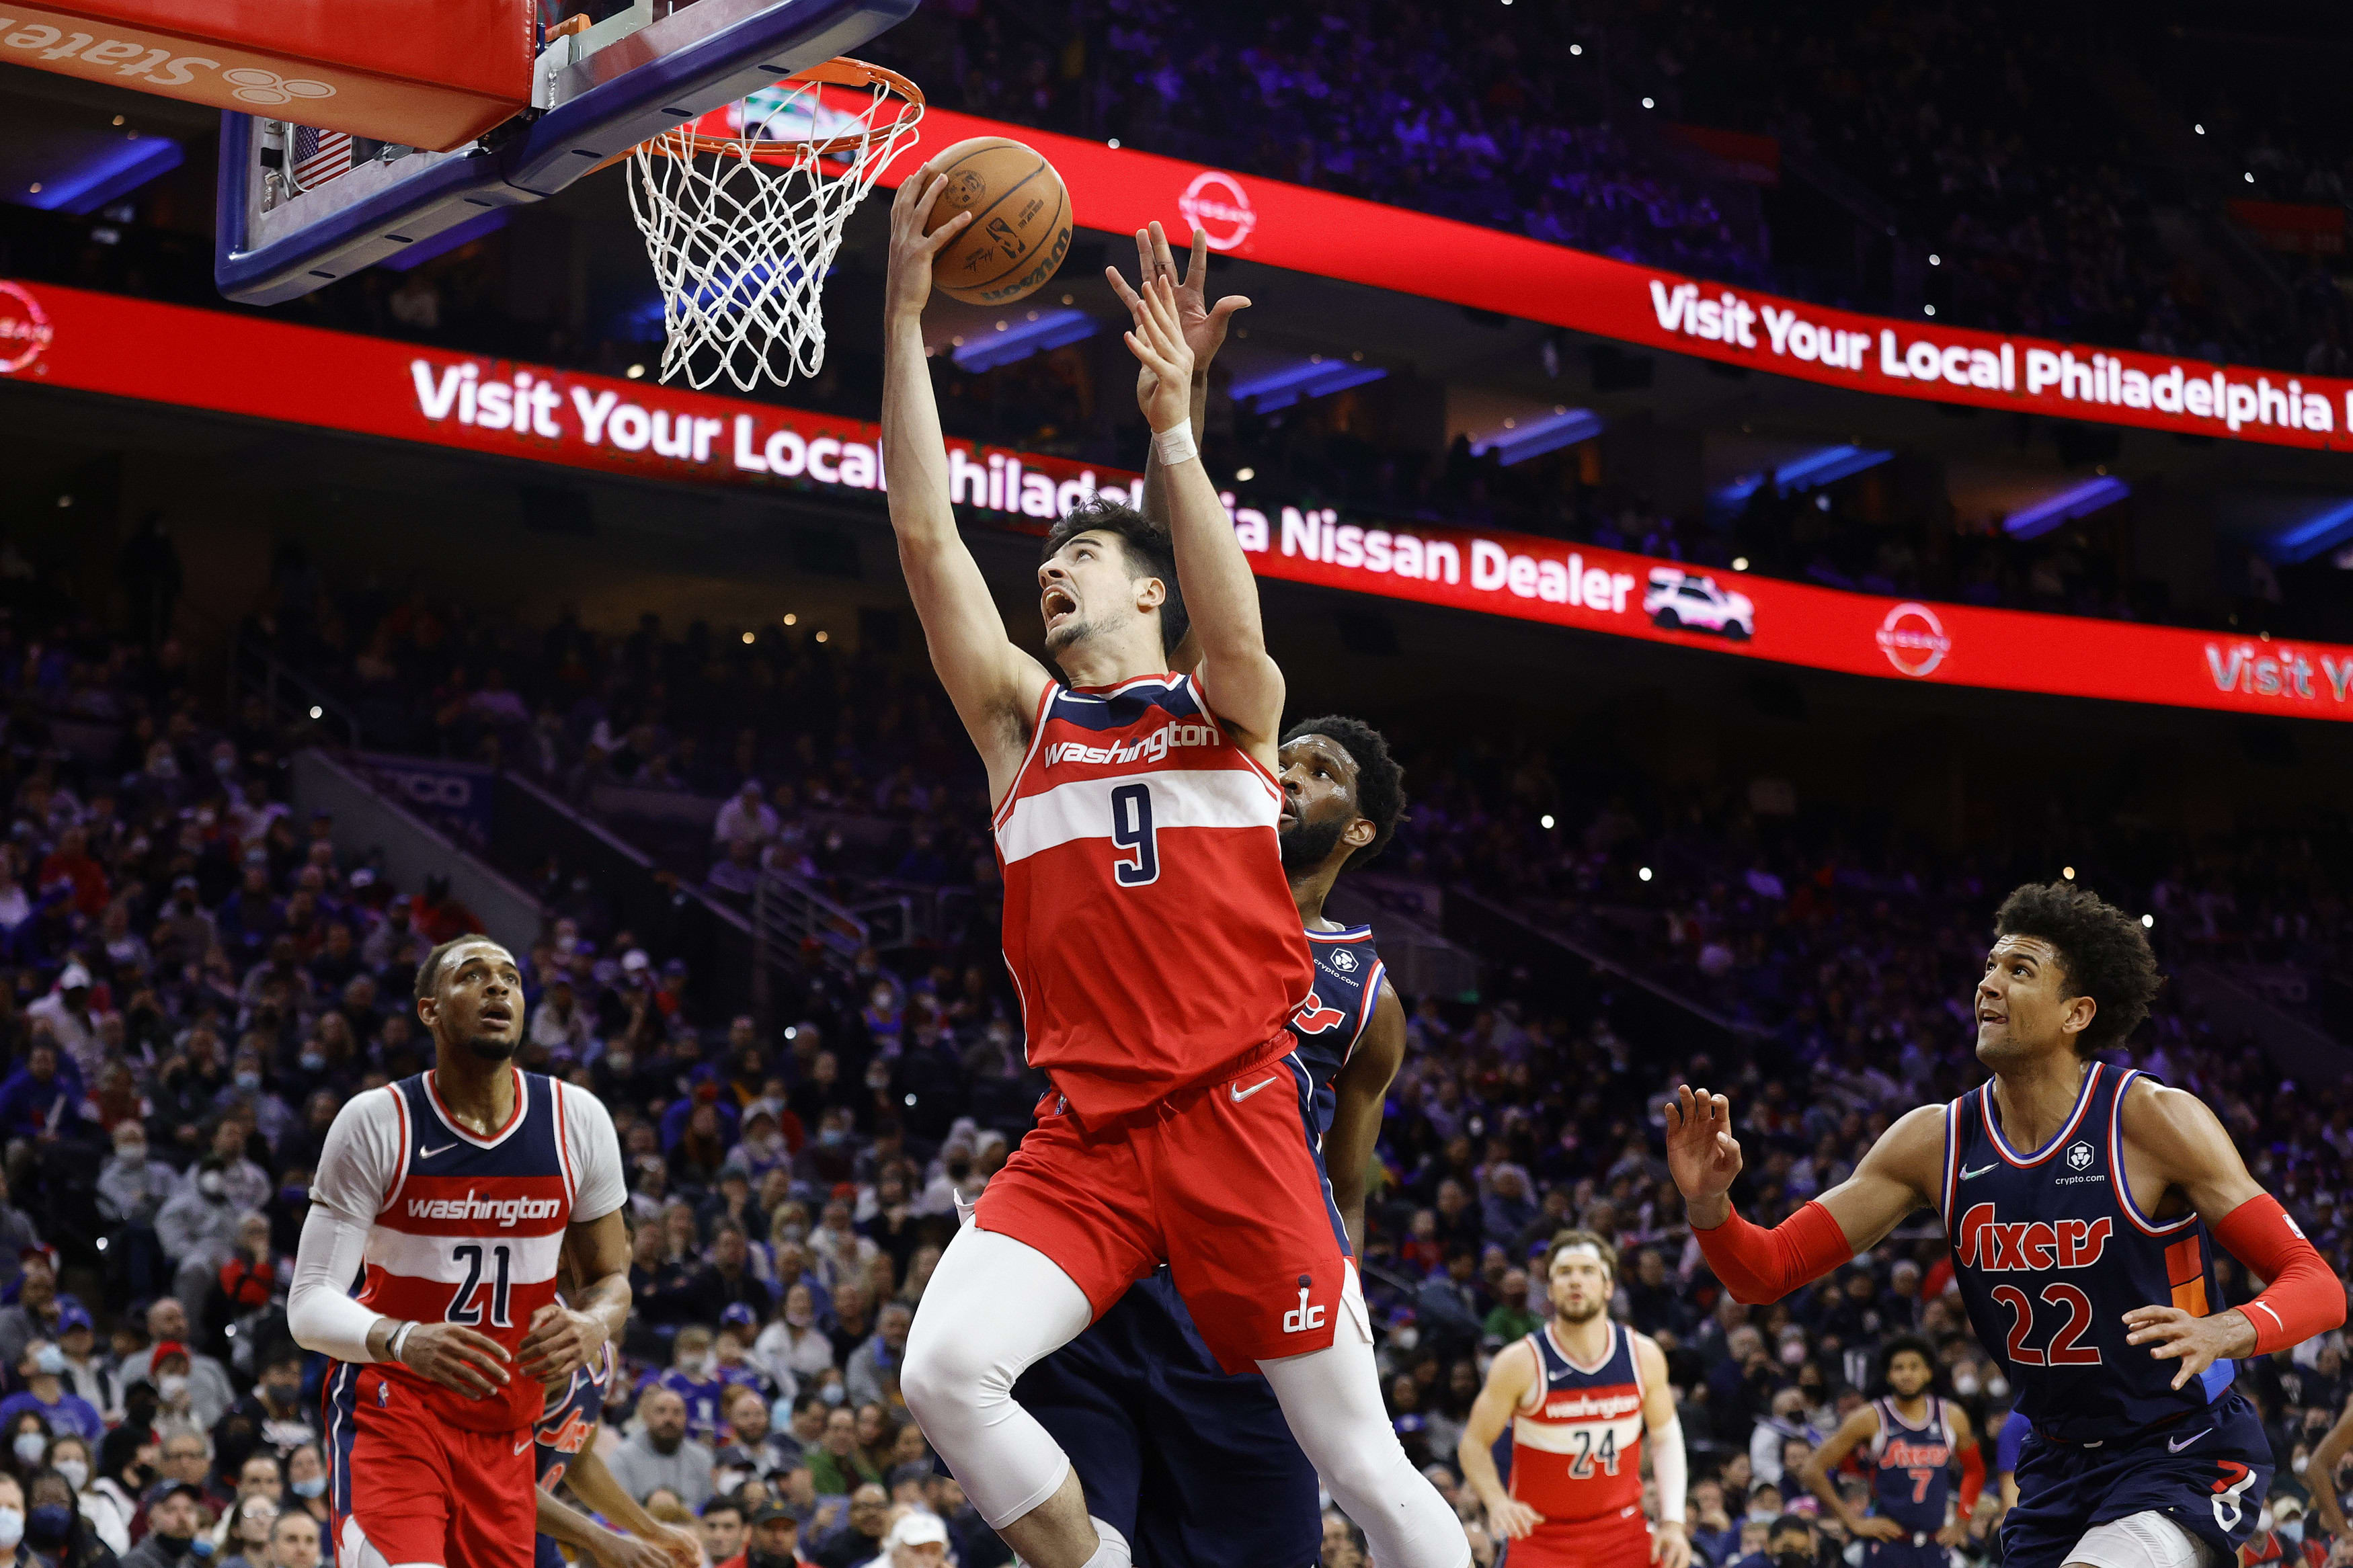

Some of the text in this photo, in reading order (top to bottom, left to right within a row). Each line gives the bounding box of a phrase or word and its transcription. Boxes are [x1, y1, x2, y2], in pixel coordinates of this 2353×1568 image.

[0, 18, 221, 85] State
[1650, 280, 1757, 349] Visit
[1761, 305, 1871, 370] Your
[1880, 329, 2016, 391] Local
[2026, 347, 2334, 432] Philadelphia
[411, 360, 561, 438] Visit
[571, 386, 723, 464] Your
[1281, 506, 1461, 585] Nissan
[1470, 538, 1636, 614] Dealer
[2205, 642, 2315, 700] Visit
[1045, 720, 1219, 768] washington
[1109, 779, 1160, 887] 9
[1313, 958, 1359, 988] crypto.com
[407, 1189, 561, 1227] washington
[2055, 1174, 2105, 1185] crypto.com
[1955, 1202, 2113, 1271] Sixers
[444, 1244, 514, 1328] 21
[1991, 1282, 2102, 1366] 22
[1546, 1393, 1640, 1419] washington
[1568, 1428, 1621, 1480] 24
[1908, 1468, 1934, 1504] 7
